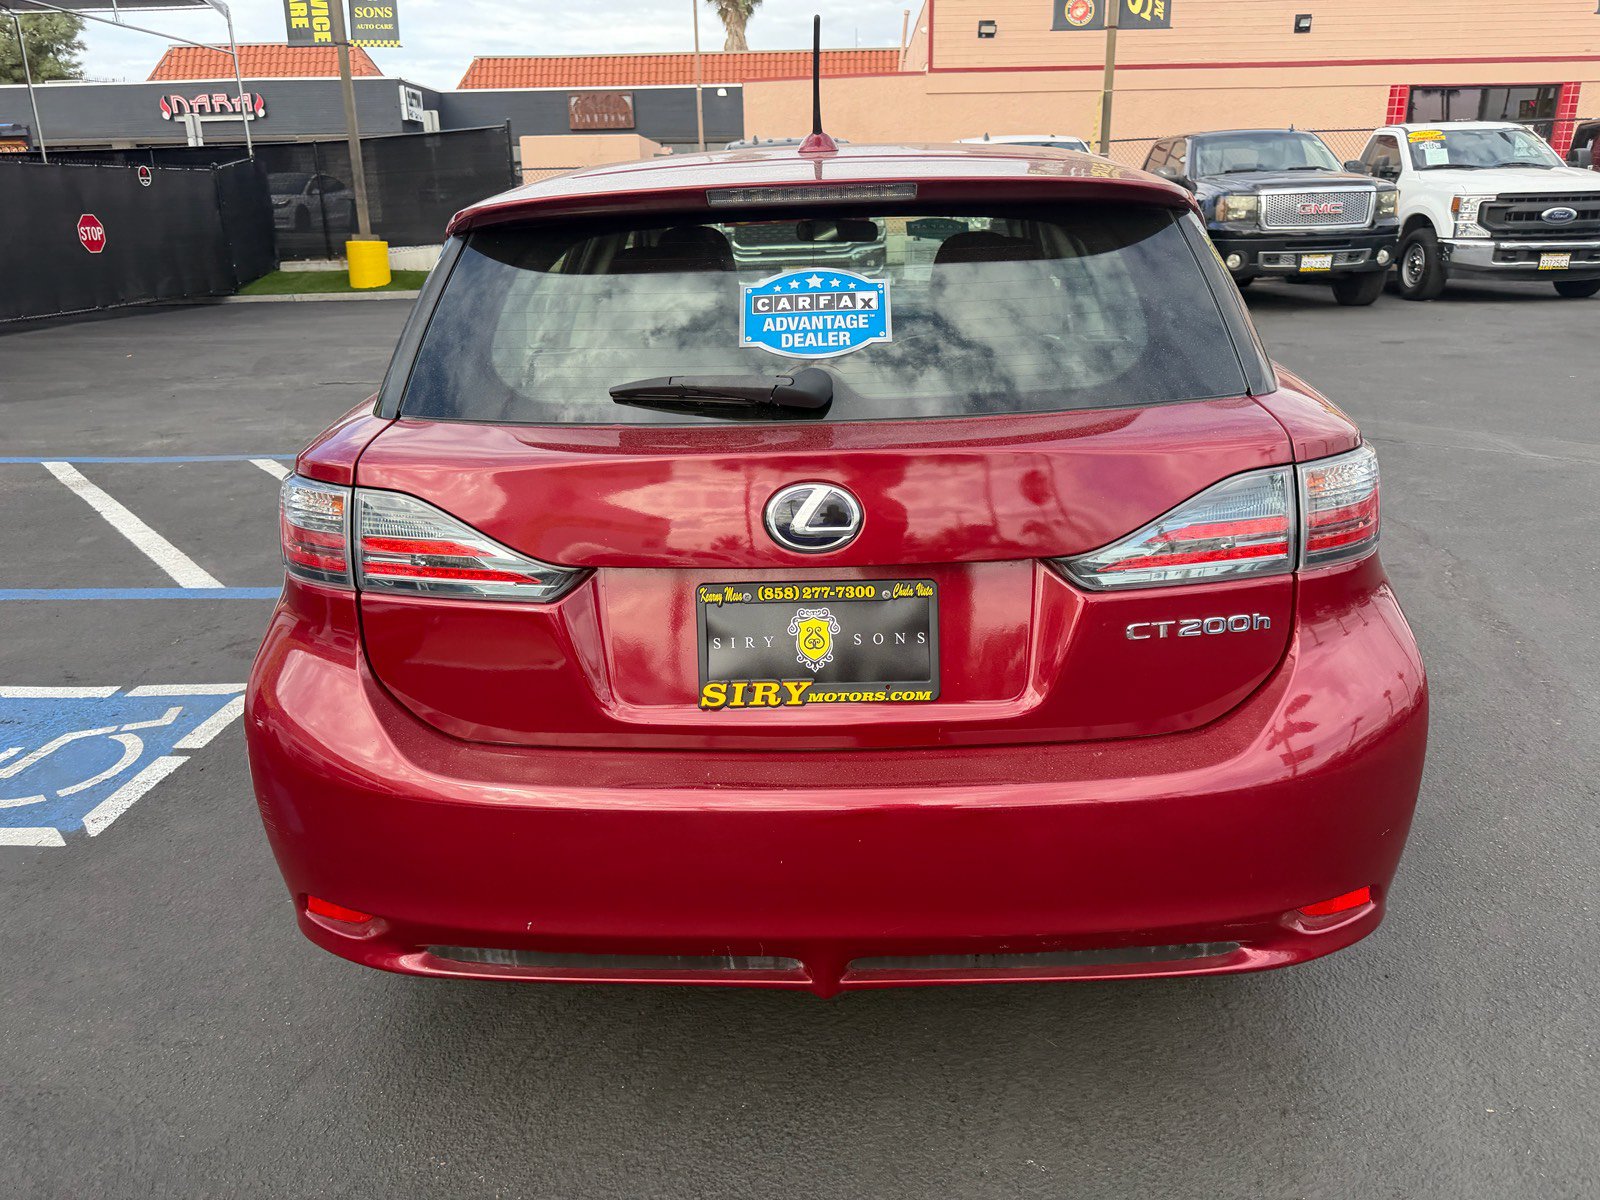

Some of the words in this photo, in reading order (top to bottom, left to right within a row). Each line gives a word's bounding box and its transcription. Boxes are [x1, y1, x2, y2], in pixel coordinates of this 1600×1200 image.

[288, 0, 310, 29] RE
[354, 6, 393, 19] SONS
[170, 93, 253, 114] NARA
[1299, 204, 1343, 215] GMC
[1551, 211, 1569, 219] Ford
[80, 226, 103, 241] STOP
[755, 293, 876, 313] CARFAX
[781, 331, 851, 348] DEALER
[699, 586, 723, 606] Kearny
[724, 586, 743, 602] Mesa
[757, 585, 800, 601] (858)
[802, 585, 876, 599] 277-7300
[892, 582, 914, 599] Chula
[915, 582, 934, 597] Vista
[713, 636, 774, 649] SIRY
[853, 632, 926, 645] SONS
